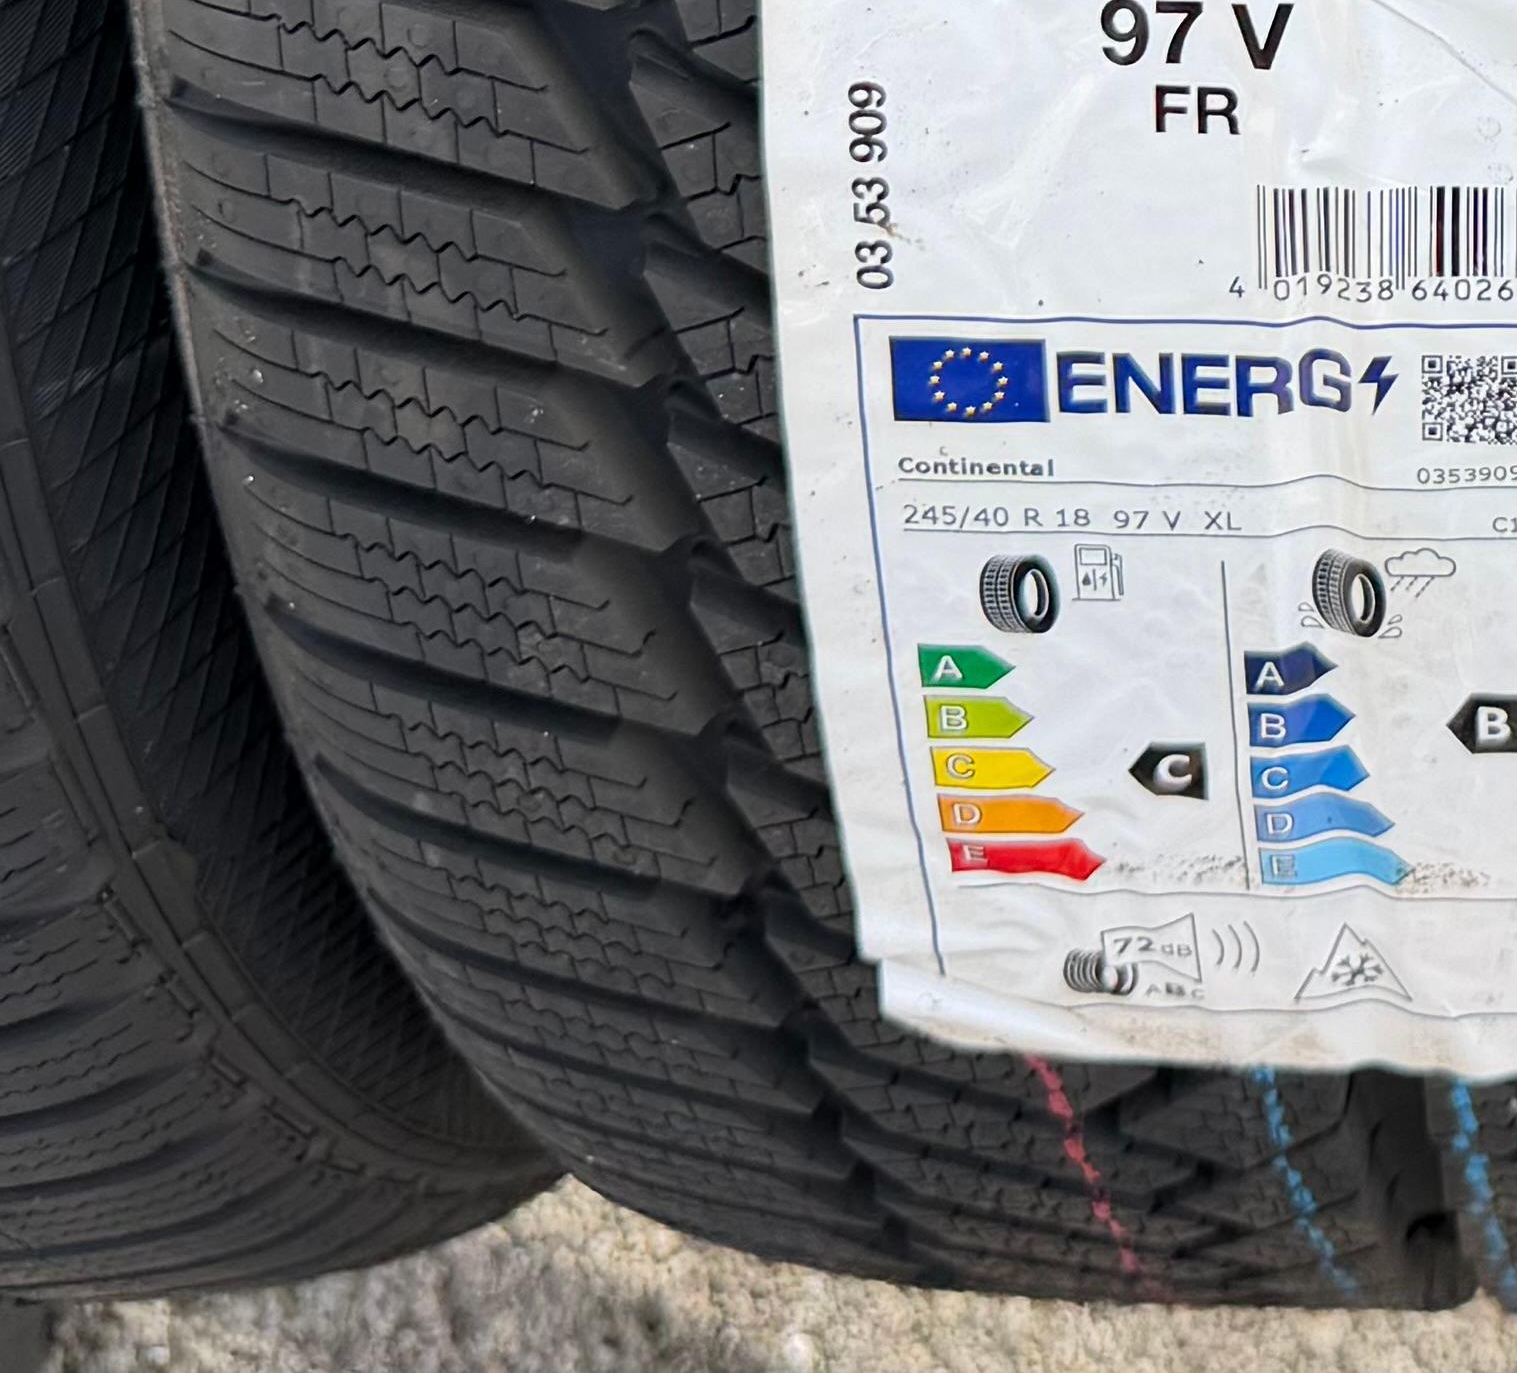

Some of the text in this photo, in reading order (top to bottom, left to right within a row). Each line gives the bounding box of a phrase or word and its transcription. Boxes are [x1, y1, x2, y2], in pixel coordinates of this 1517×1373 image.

[1232, 1, 1295, 72] V
[1154, 85, 1241, 135] FR
[847, 81, 894, 290] 03 53 909
[1228, 275, 1246, 299] 4
[1273, 273, 1395, 303] 019238
[897, 457, 1055, 477] Continental
[903, 504, 1010, 529] 245/40
[1023, 507, 1044, 528] R
[1055, 508, 1092, 528] 18
[1113, 509, 1149, 530] 97
[1162, 510, 1182, 530] V
[1203, 511, 1243, 530] XL
[936, 654, 964, 683] A
[1256, 661, 1285, 689] A
[940, 705, 968, 733] B
[1260, 713, 1286, 741] B
[1475, 707, 1513, 744] B
[945, 754, 976, 780] C
[1155, 753, 1194, 792] C
[1261, 766, 1289, 791] C
[952, 802, 983, 827] D
[1265, 810, 1294, 835] D
[1112, 936, 1157, 955] 72
